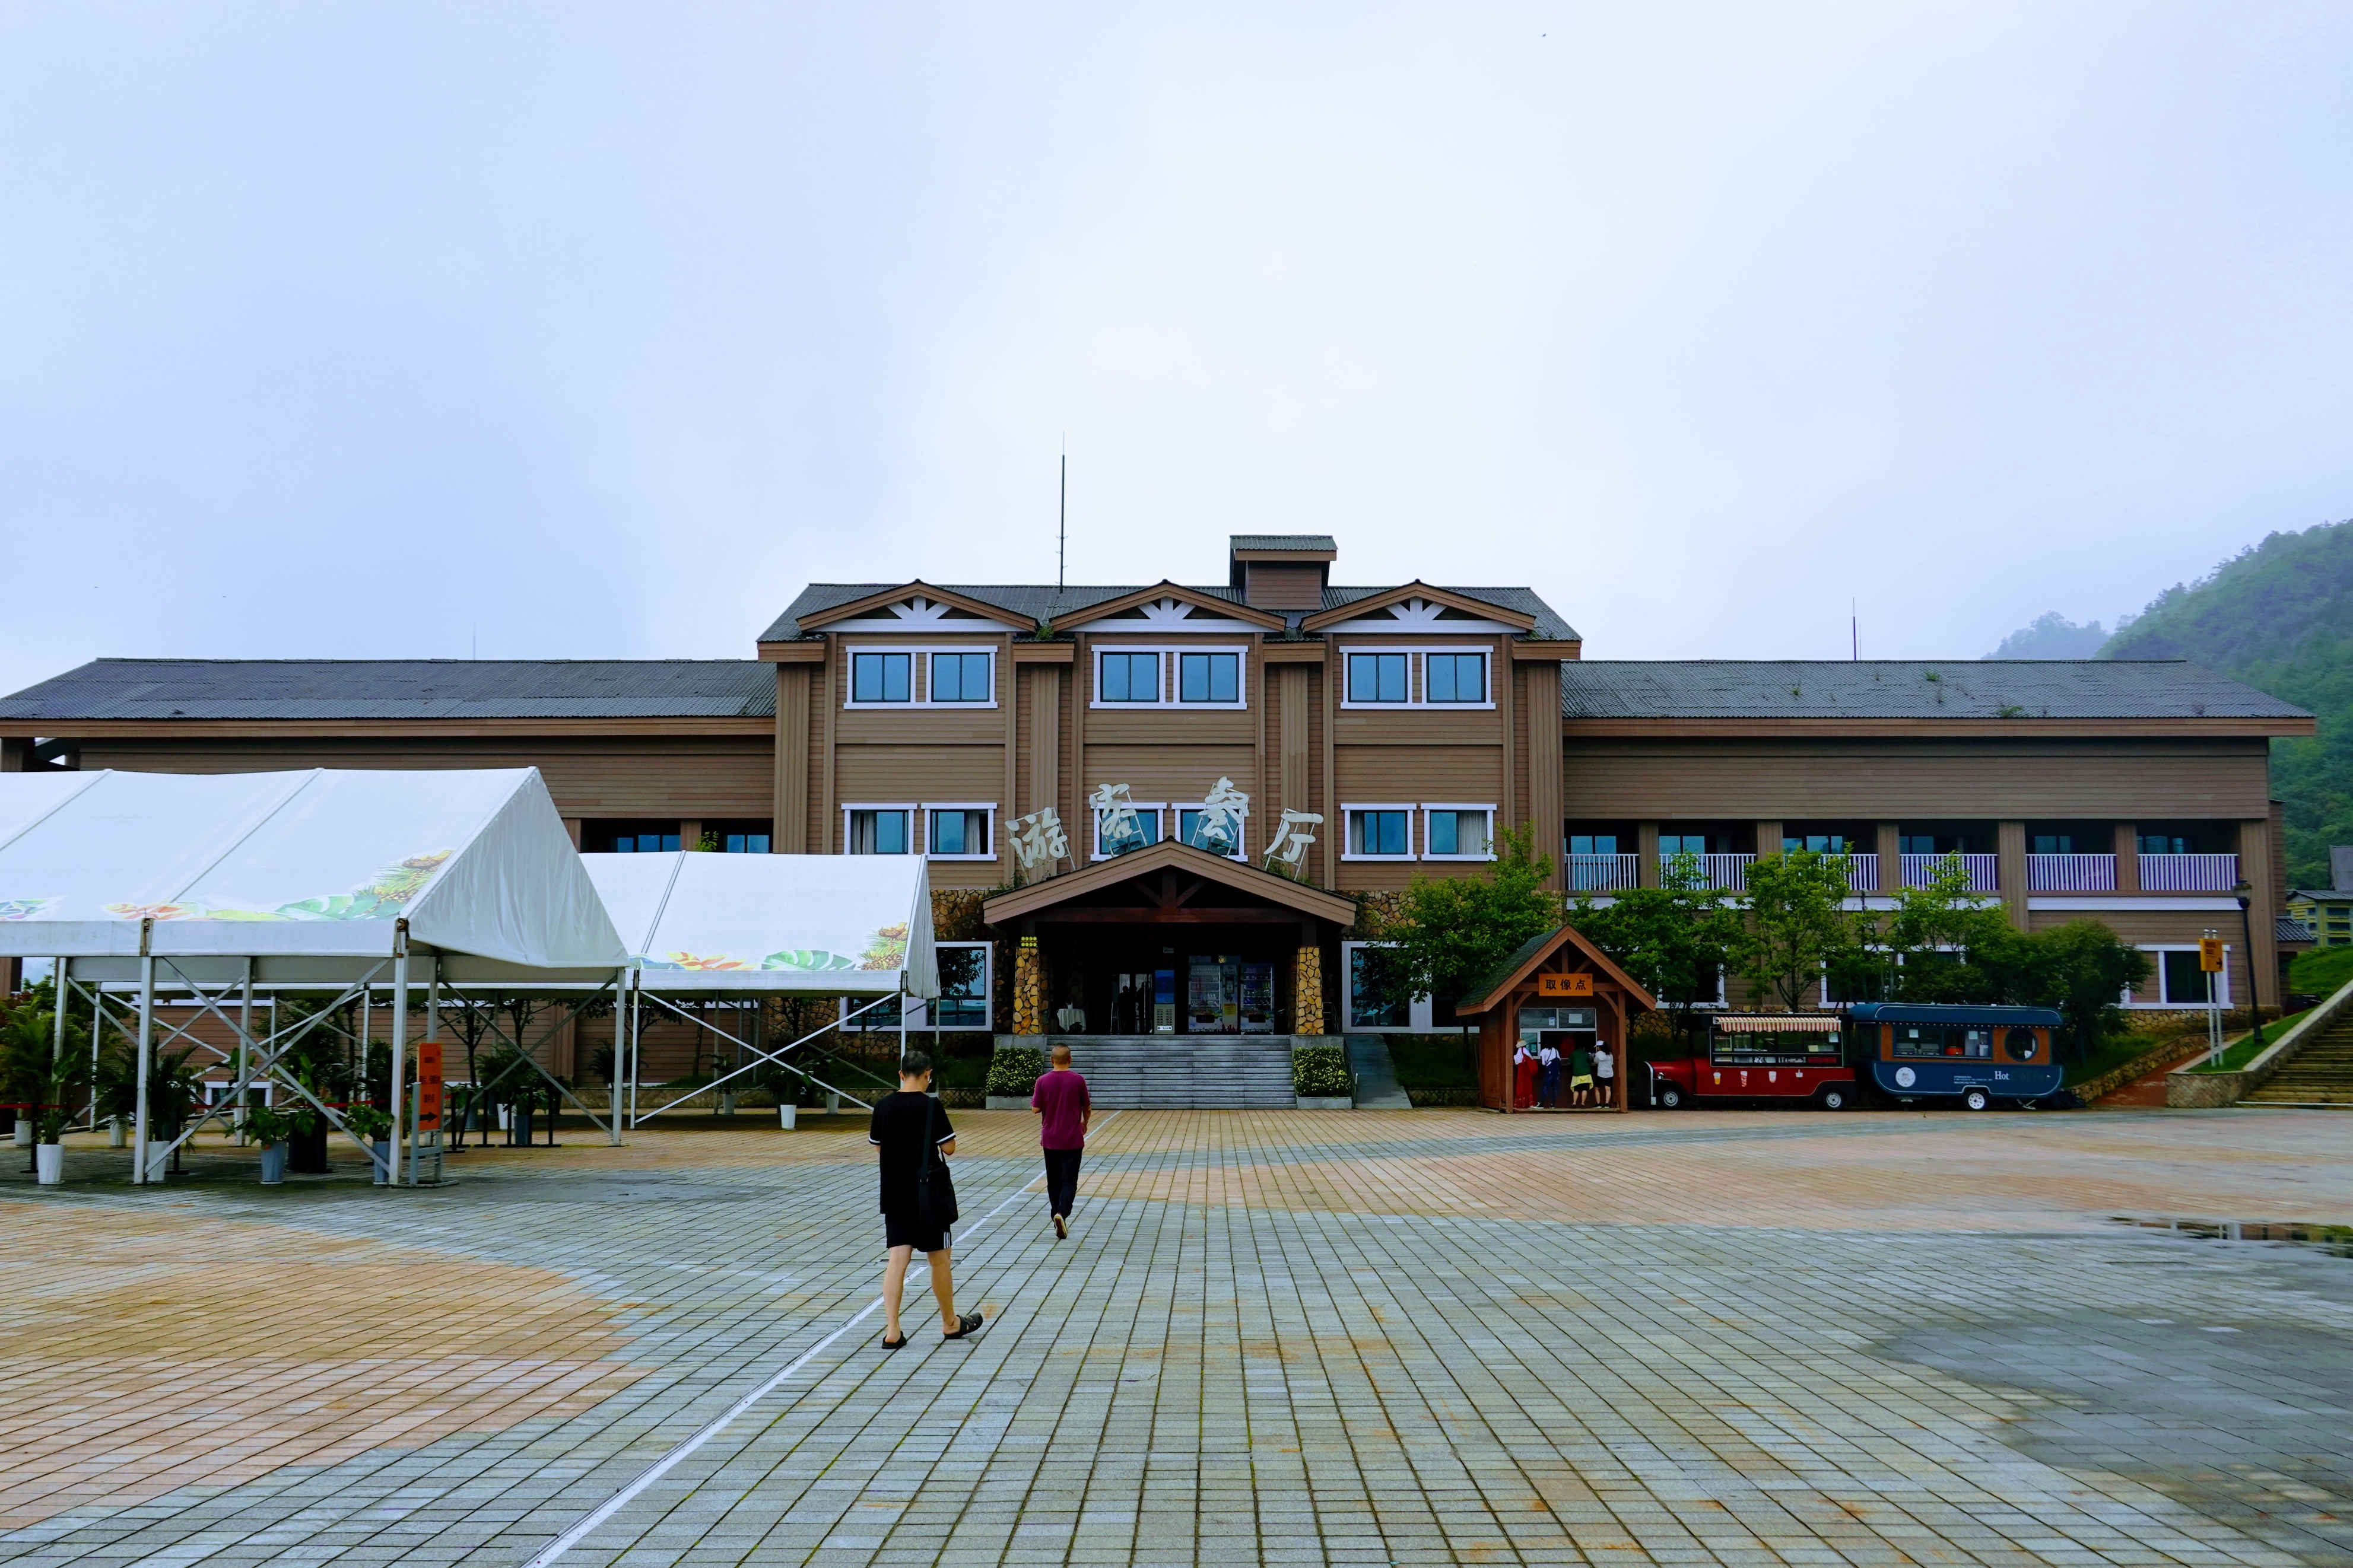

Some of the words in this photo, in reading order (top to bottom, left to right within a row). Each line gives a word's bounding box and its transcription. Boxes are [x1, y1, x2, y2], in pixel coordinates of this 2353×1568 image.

[1545, 979, 1586, 990] 取像点
[1994, 1070, 2010, 1080] Hot
